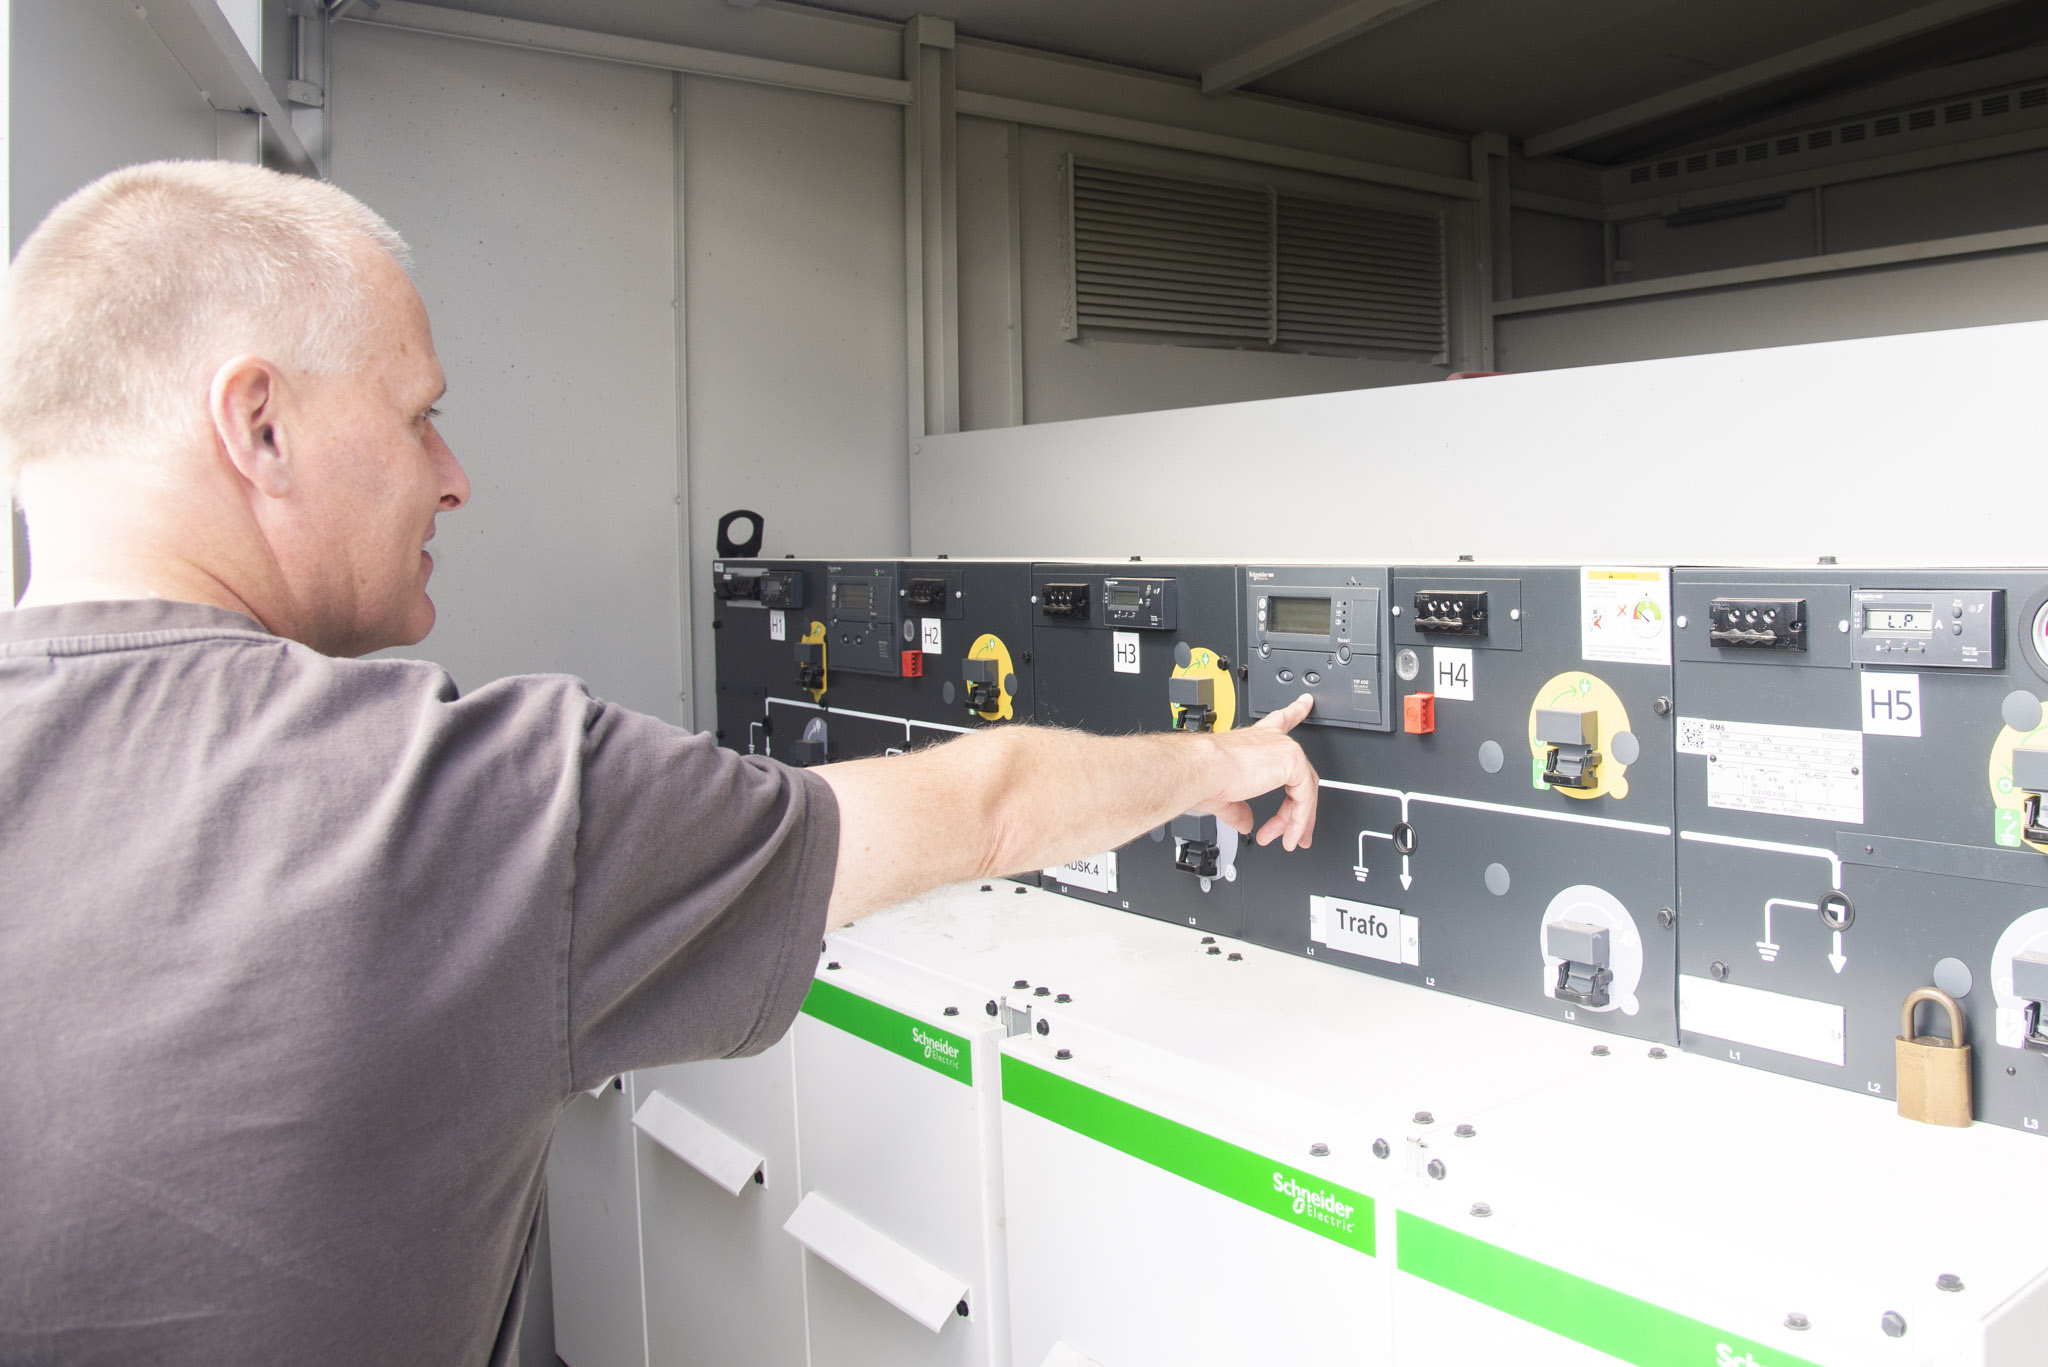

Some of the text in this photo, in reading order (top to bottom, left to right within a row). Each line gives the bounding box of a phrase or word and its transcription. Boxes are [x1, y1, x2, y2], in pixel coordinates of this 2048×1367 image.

[771, 615, 784, 634] H1
[1934, 619, 1944, 630] A
[924, 626, 939, 646] H2
[1117, 643, 1136, 664] H3
[1439, 661, 1469, 688] H4
[1870, 689, 1913, 721] H5
[1122, 900, 1130, 909] L2
[1188, 916, 1197, 926] L3
[1335, 908, 1389, 939] Trafo
[1306, 946, 1315, 956] L1
[1425, 976, 1436, 987] L2
[1564, 1010, 1576, 1022] L3
[912, 1027, 960, 1059] Schneider
[932, 1050, 960, 1070] Electric
[1728, 1048, 1742, 1061] L1
[1867, 1080, 1882, 1094] L2
[2022, 1116, 2040, 1130] L3
[1272, 1171, 1355, 1220] Schneider
[1307, 1204, 1354, 1234] Electric
